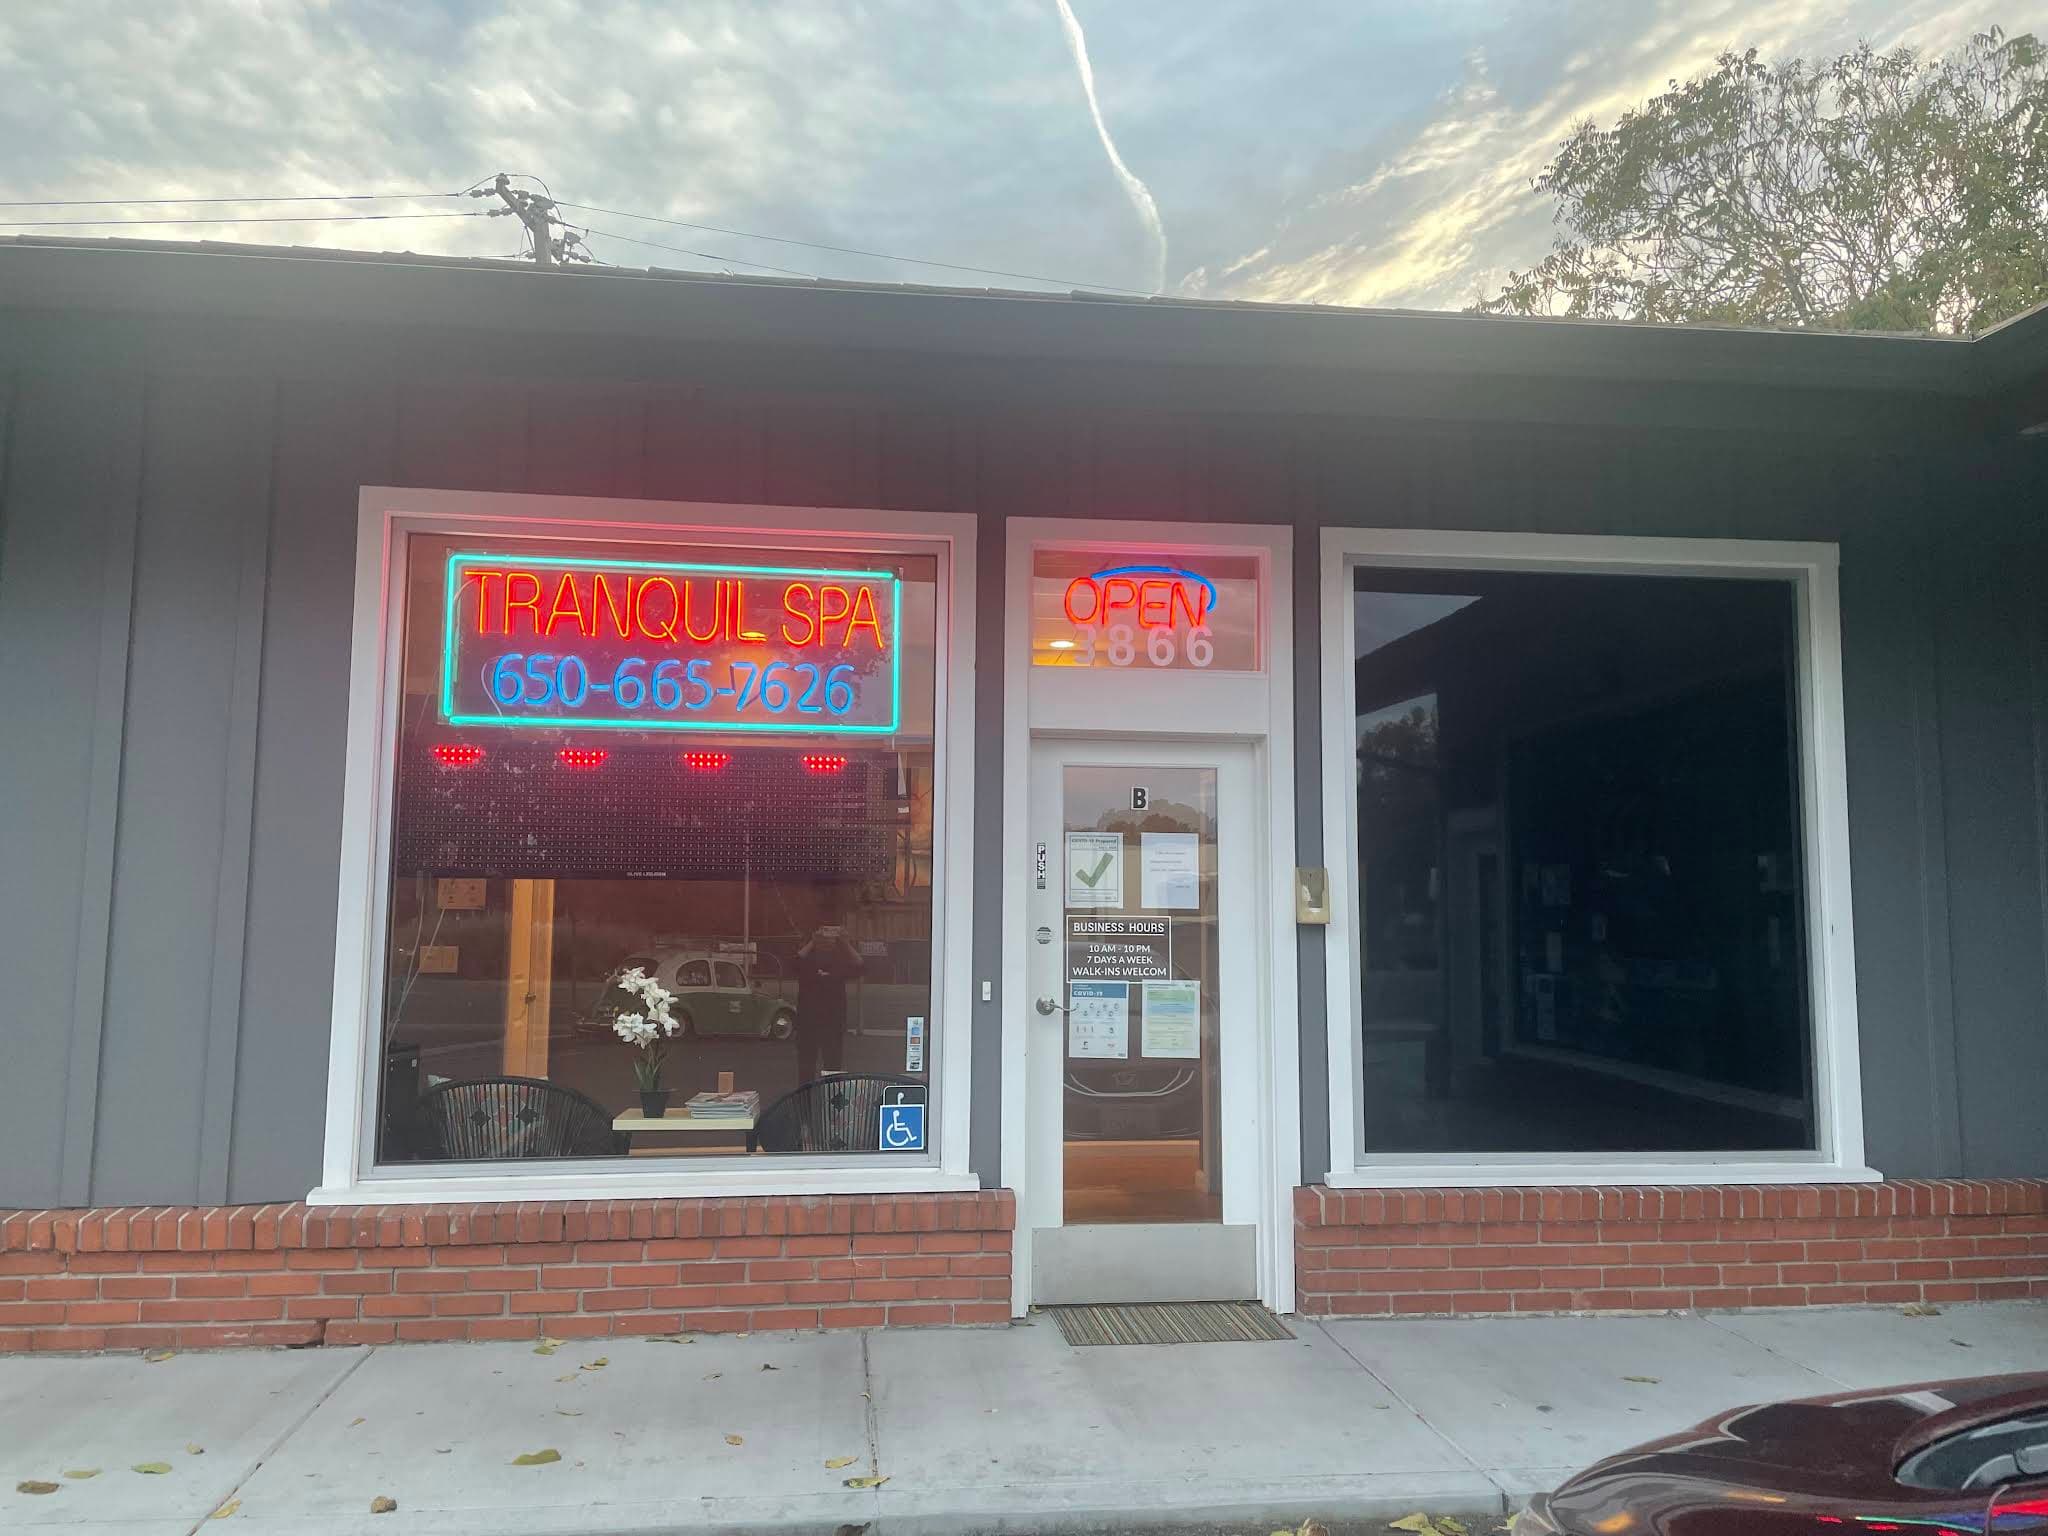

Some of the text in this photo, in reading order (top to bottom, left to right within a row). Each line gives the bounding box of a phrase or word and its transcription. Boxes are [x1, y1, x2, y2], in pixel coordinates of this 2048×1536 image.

[464, 570, 885, 649] TRANQUIL SPA
[1064, 576, 1207, 630] OPEN
[1073, 624, 1214, 667] 3866
[492, 653, 855, 715] 650-665-7626
[1132, 787, 1147, 809] B
[1037, 844, 1046, 879] PUSH
[1073, 922, 1165, 933] BUSINESS HOURS
[1087, 955, 1153, 964] 7 DAYS A WEEK
[1089, 944, 1100, 953] 10
[1101, 944, 1116, 953] AM
[1124, 944, 1135, 953] 10
[1136, 944, 1151, 953] PM
[1072, 967, 1167, 976] WALK-INS WELCOM
